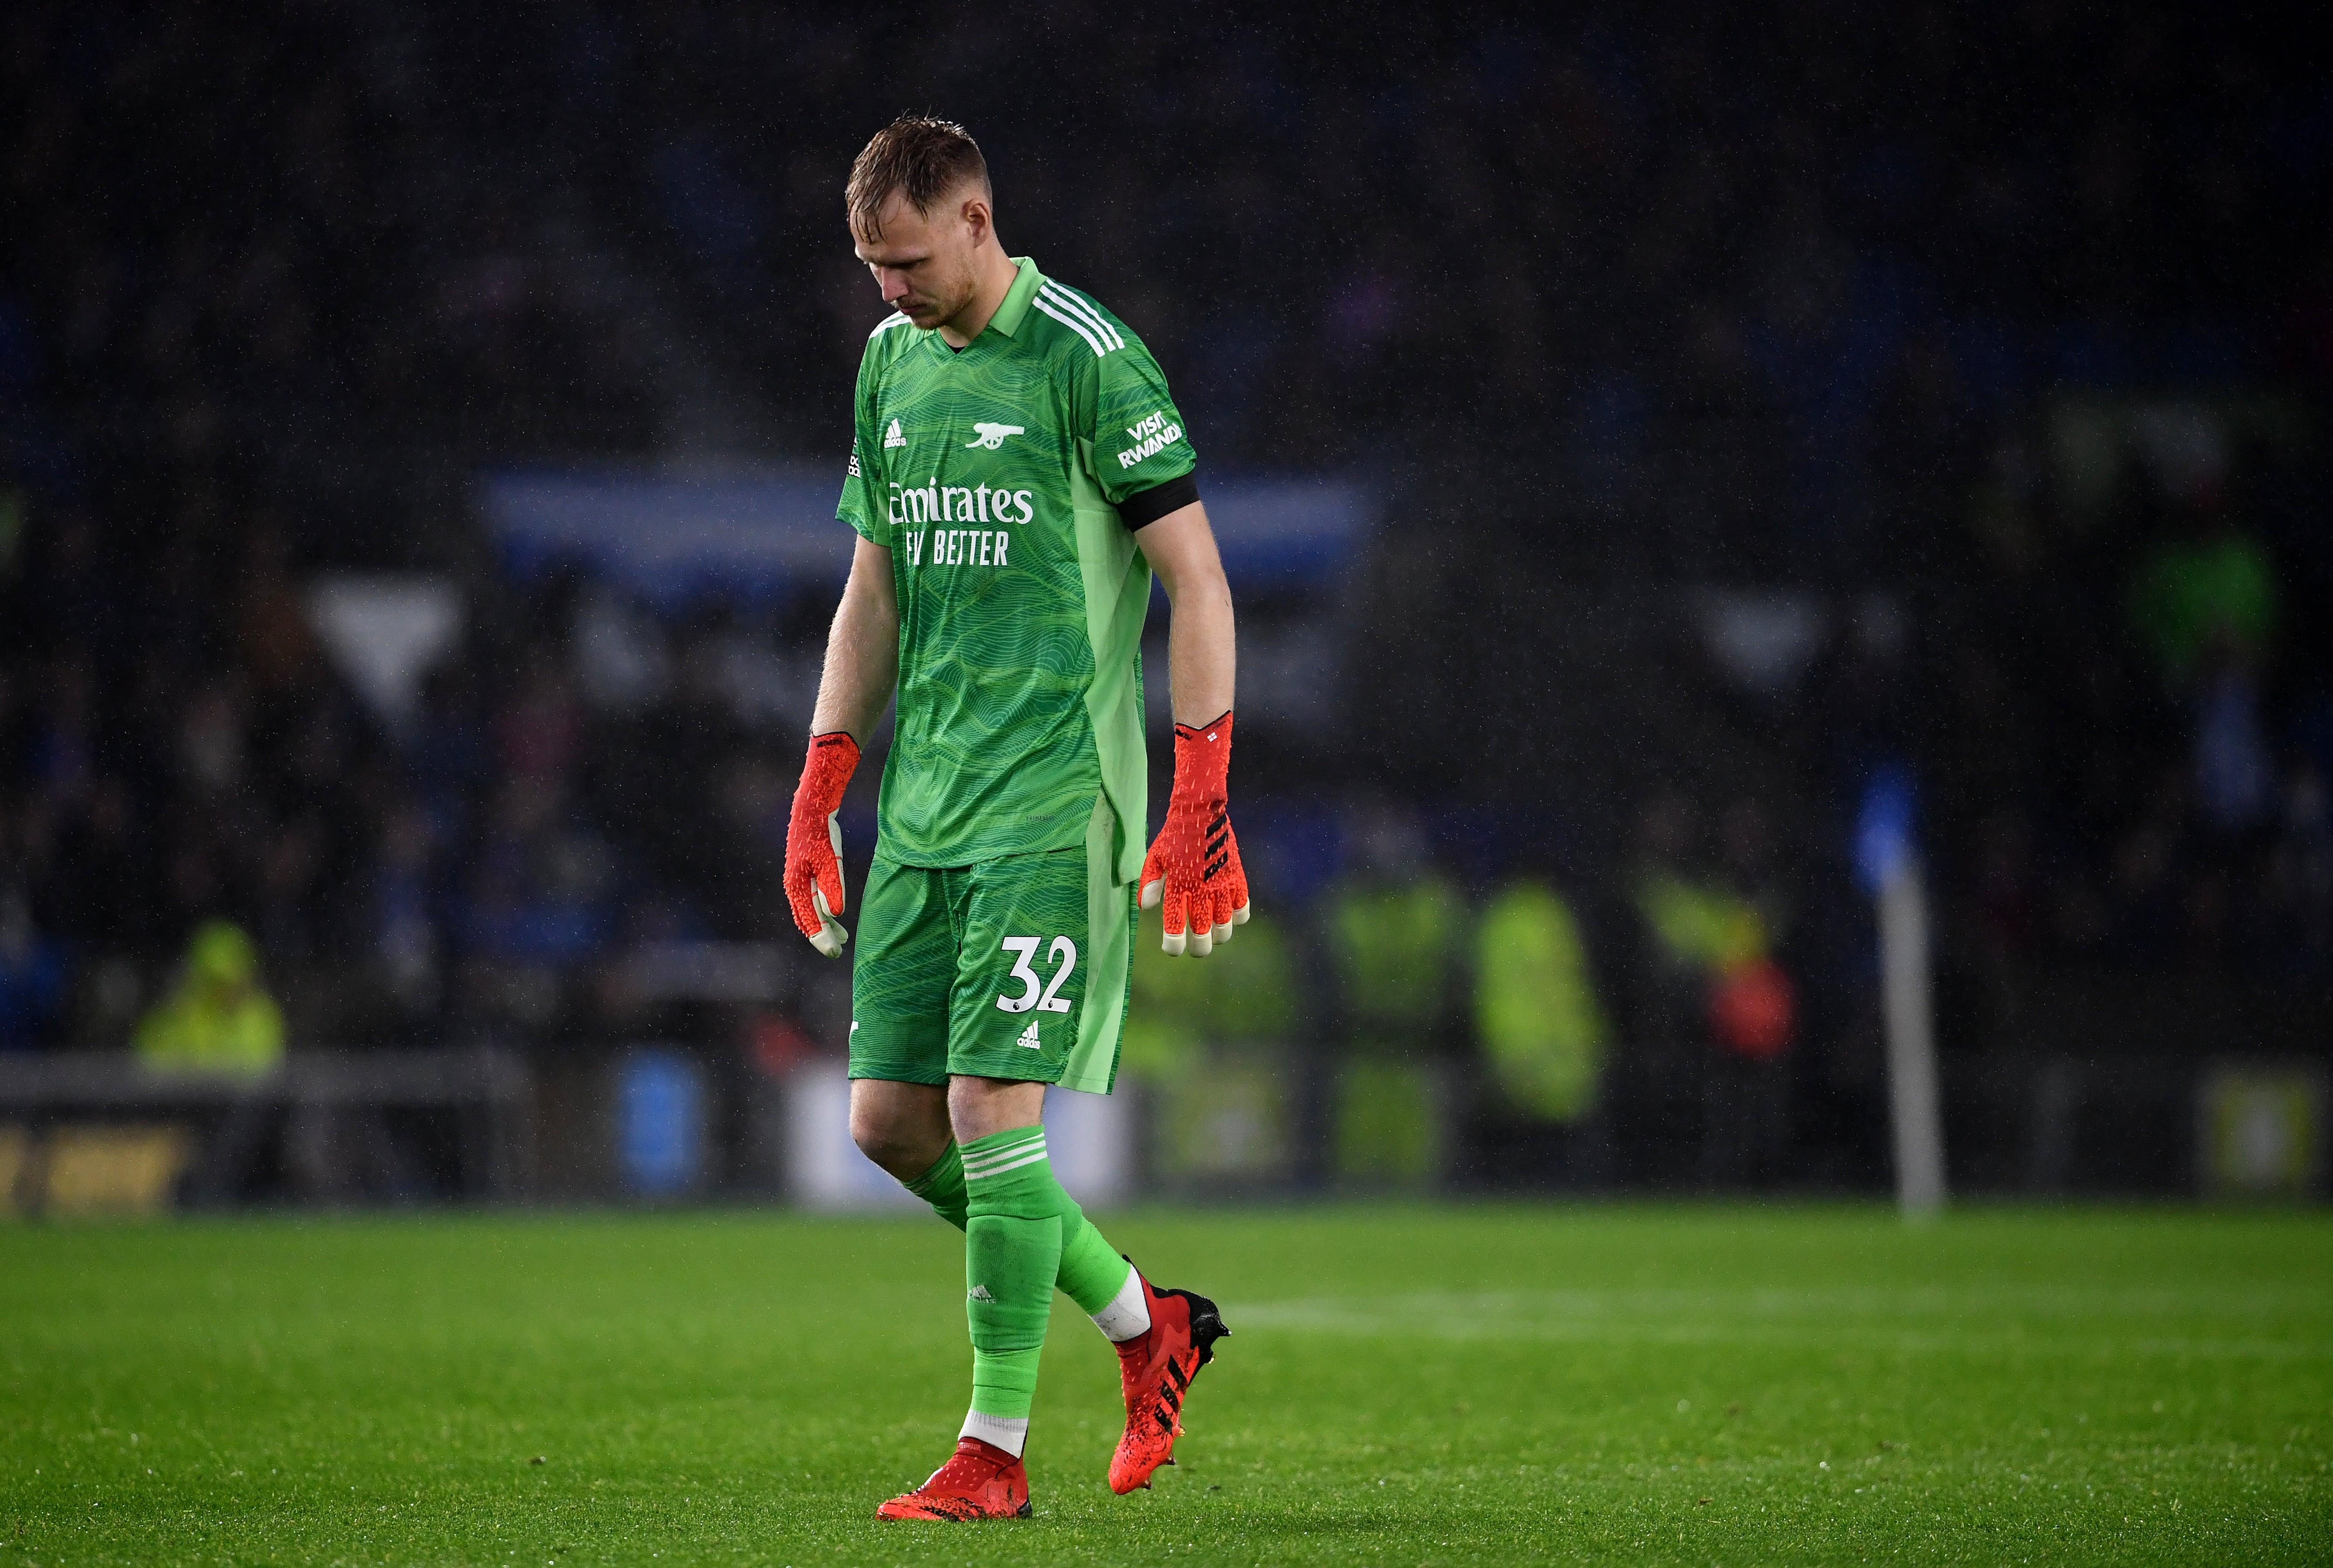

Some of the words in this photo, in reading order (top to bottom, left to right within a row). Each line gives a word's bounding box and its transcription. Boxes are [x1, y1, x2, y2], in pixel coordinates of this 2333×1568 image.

[889, 477, 1033, 525] Emirates
[934, 530, 1009, 566] BETTER
[995, 935, 1077, 1013] 32
